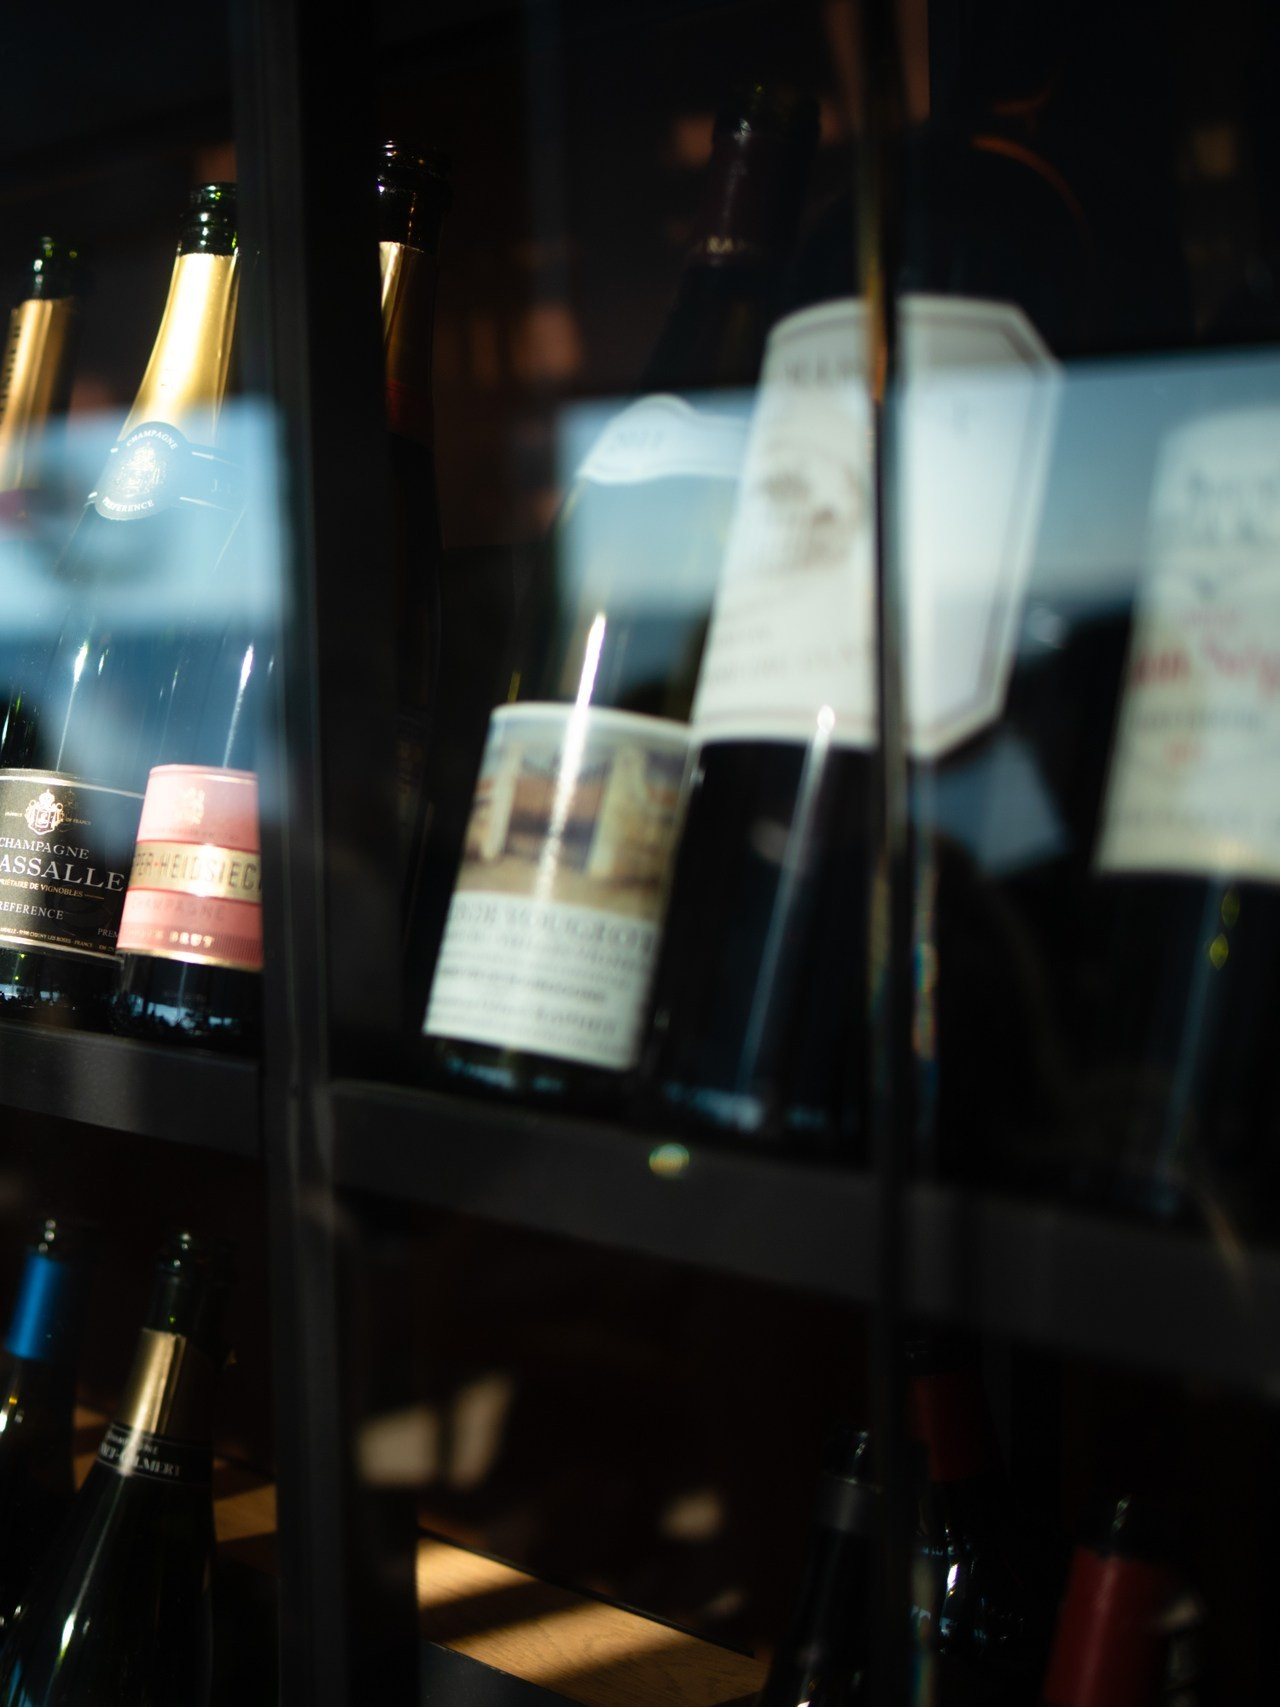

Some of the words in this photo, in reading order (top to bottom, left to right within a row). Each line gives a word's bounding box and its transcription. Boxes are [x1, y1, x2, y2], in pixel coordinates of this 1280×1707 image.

[126, 429, 178, 450] CHAMPAGNE
[29, 882, 39, 890] DE
[40, 883, 84, 898] VIGNOBLES
[169, 930, 216, 949] BRUT
